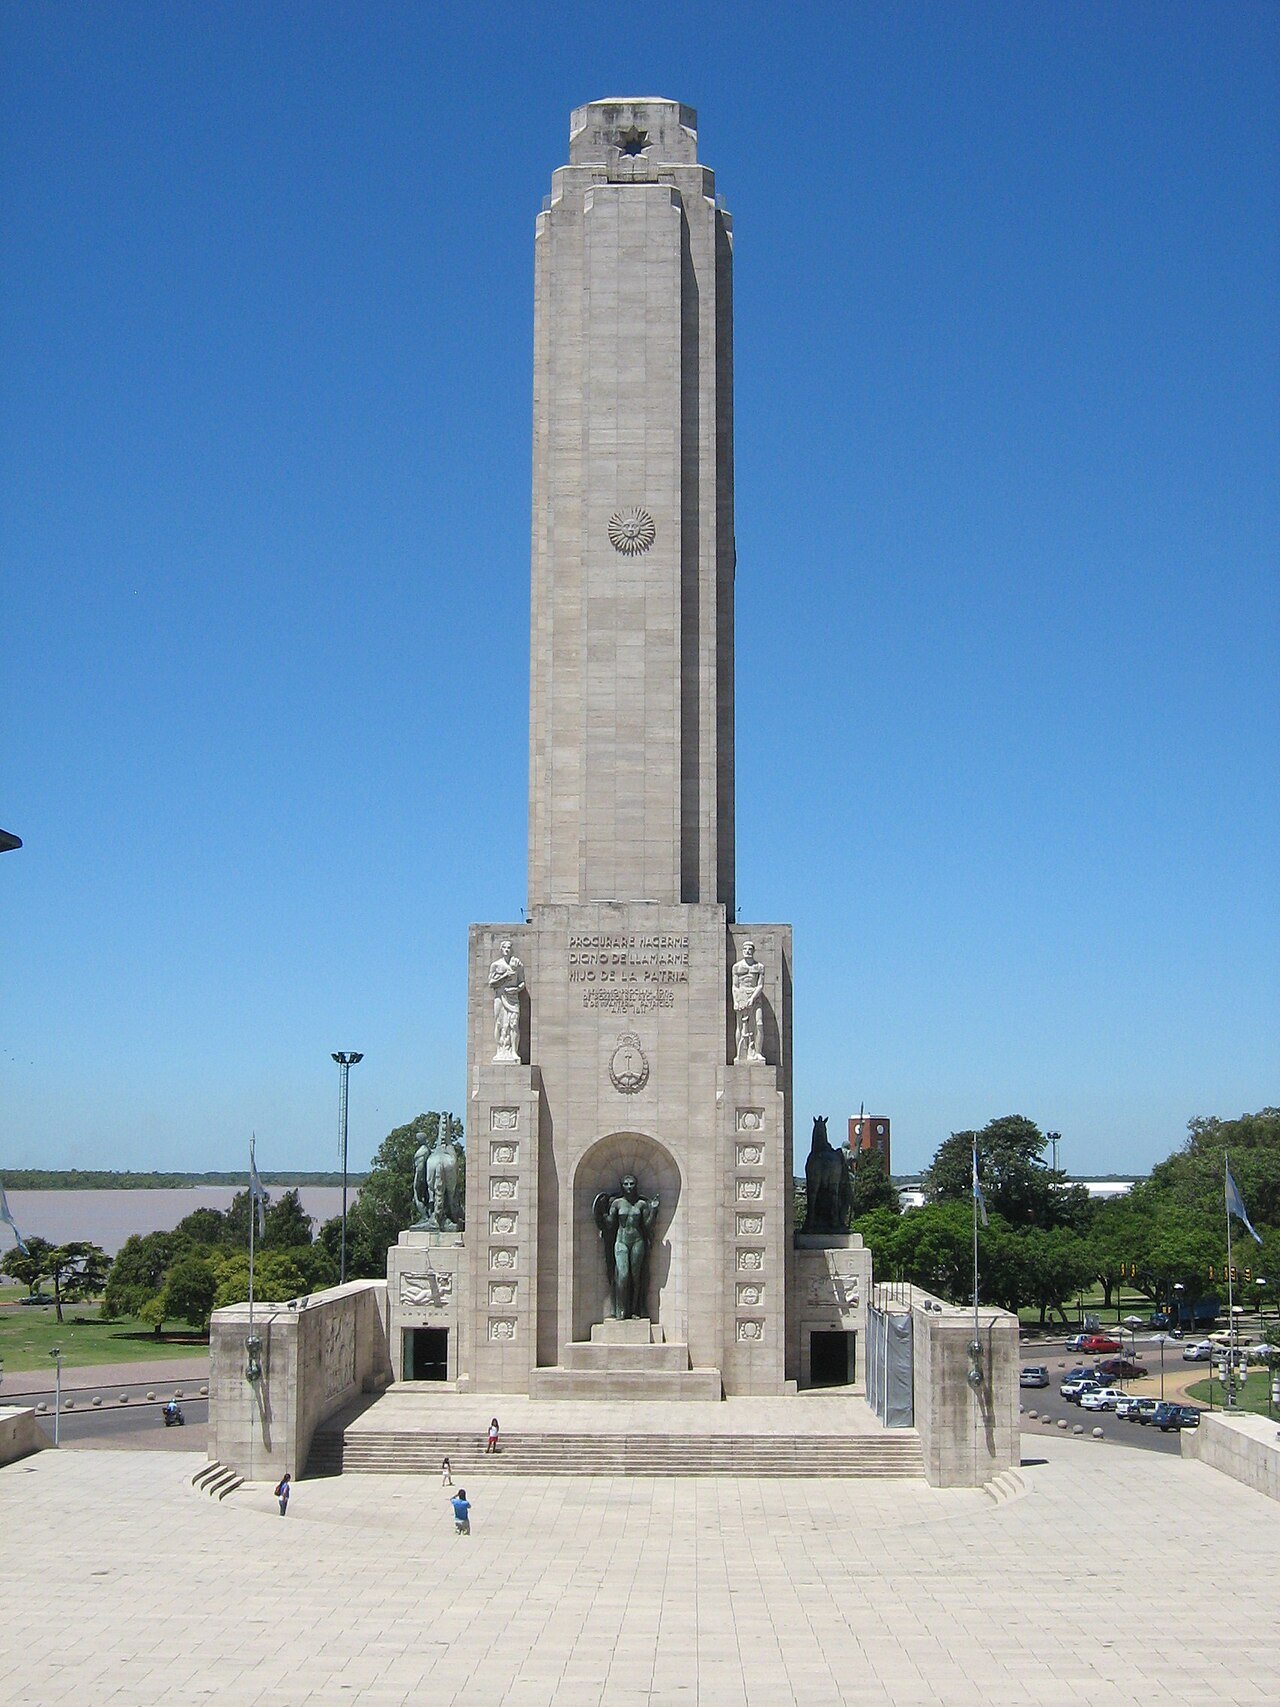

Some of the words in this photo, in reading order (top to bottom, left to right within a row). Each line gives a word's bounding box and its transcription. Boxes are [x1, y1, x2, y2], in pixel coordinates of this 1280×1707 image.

[639, 936, 689, 948] HACERME
[569, 953, 609, 965] DIGNO
[611, 953, 627, 965] DE
[629, 953, 689, 965] LLAMARME
[569, 970, 596, 982] HIJO
[600, 970, 615, 982] DE
[621, 970, 638, 982] LA
[643, 970, 688, 982] PATRIA
